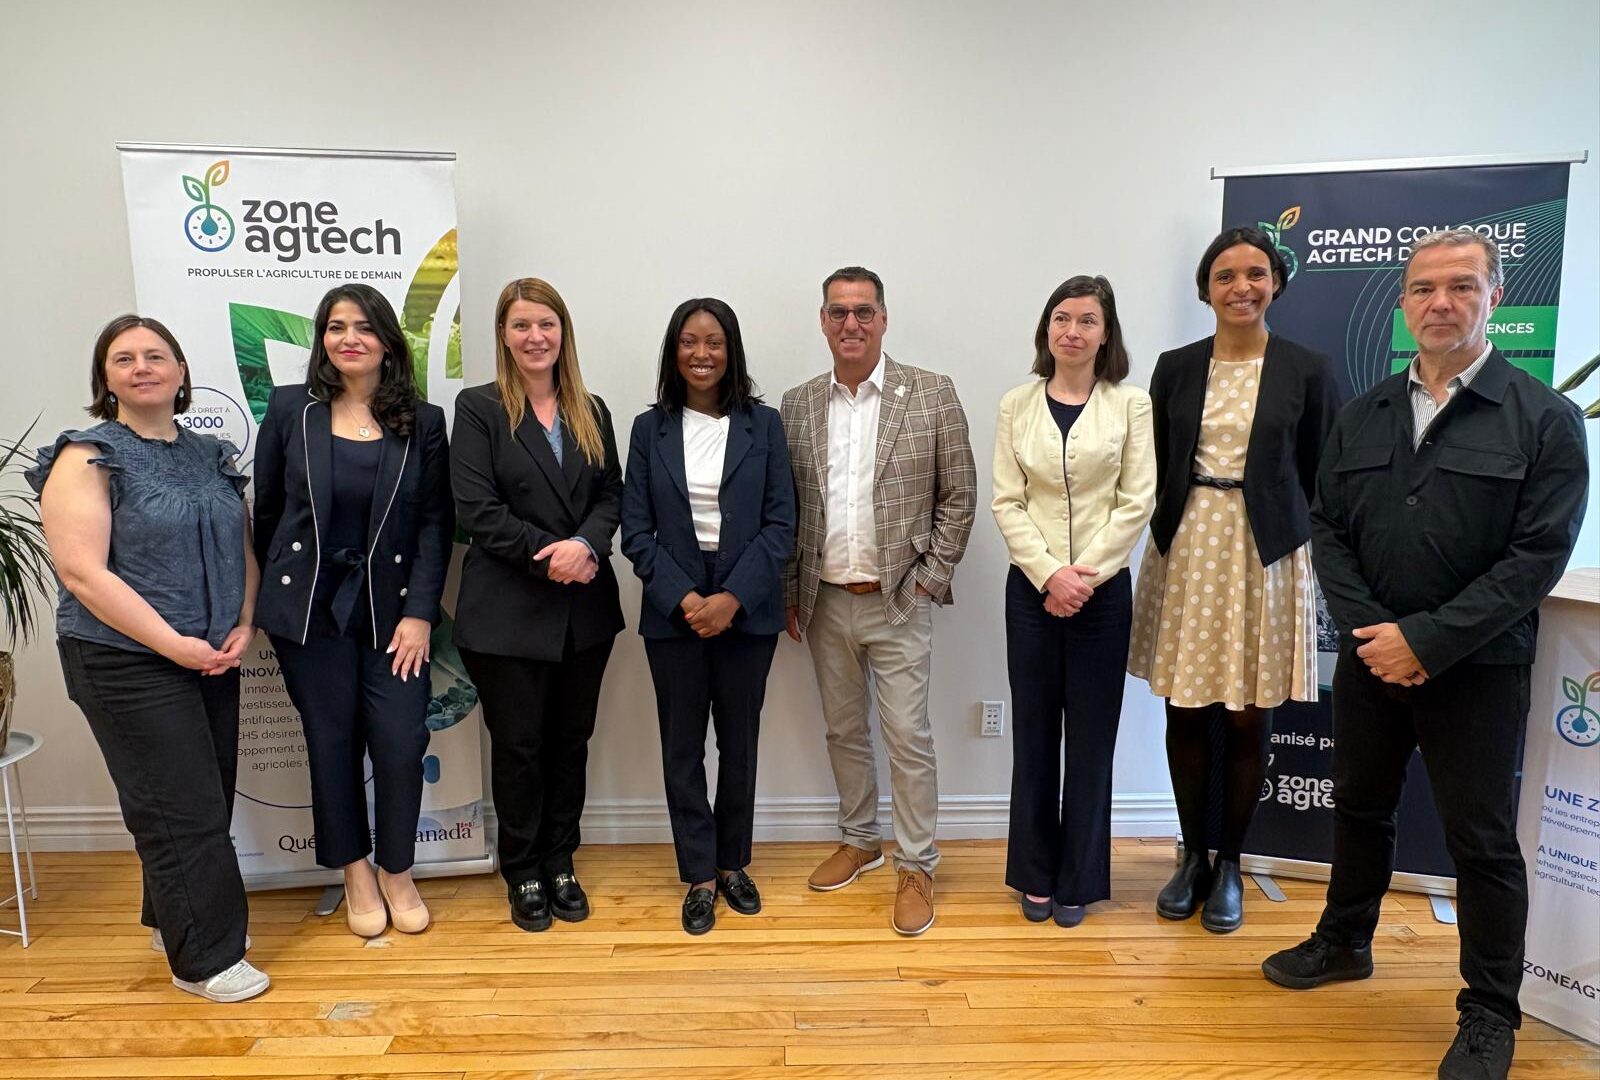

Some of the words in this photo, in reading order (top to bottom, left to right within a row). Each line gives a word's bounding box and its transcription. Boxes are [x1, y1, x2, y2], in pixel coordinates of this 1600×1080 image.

[242, 199, 338, 224] zone
[244, 218, 402, 262] agtech
[1307, 227, 1392, 246] GRAND
[1397, 222, 1527, 243] COQUE
[1306, 246, 1392, 264] AGTECH
[187, 268, 254, 278] PROPULSER
[256, 269, 342, 279] L'AGRICULTURE
[344, 270, 359, 279] DE
[360, 270, 402, 280] DEMAIN
[197, 406, 224, 414] DIRECT
[183, 416, 224, 428] 3000
[251, 759, 303, 772] agricoles
[1277, 774, 1335, 793] zone
[1544, 785, 1584, 808] UNE
[1536, 844, 1546, 855] A
[1548, 847, 1598, 871] UNIQUE
[1534, 869, 1585, 892] agricultural
[1565, 868, 1598, 883] agtech
